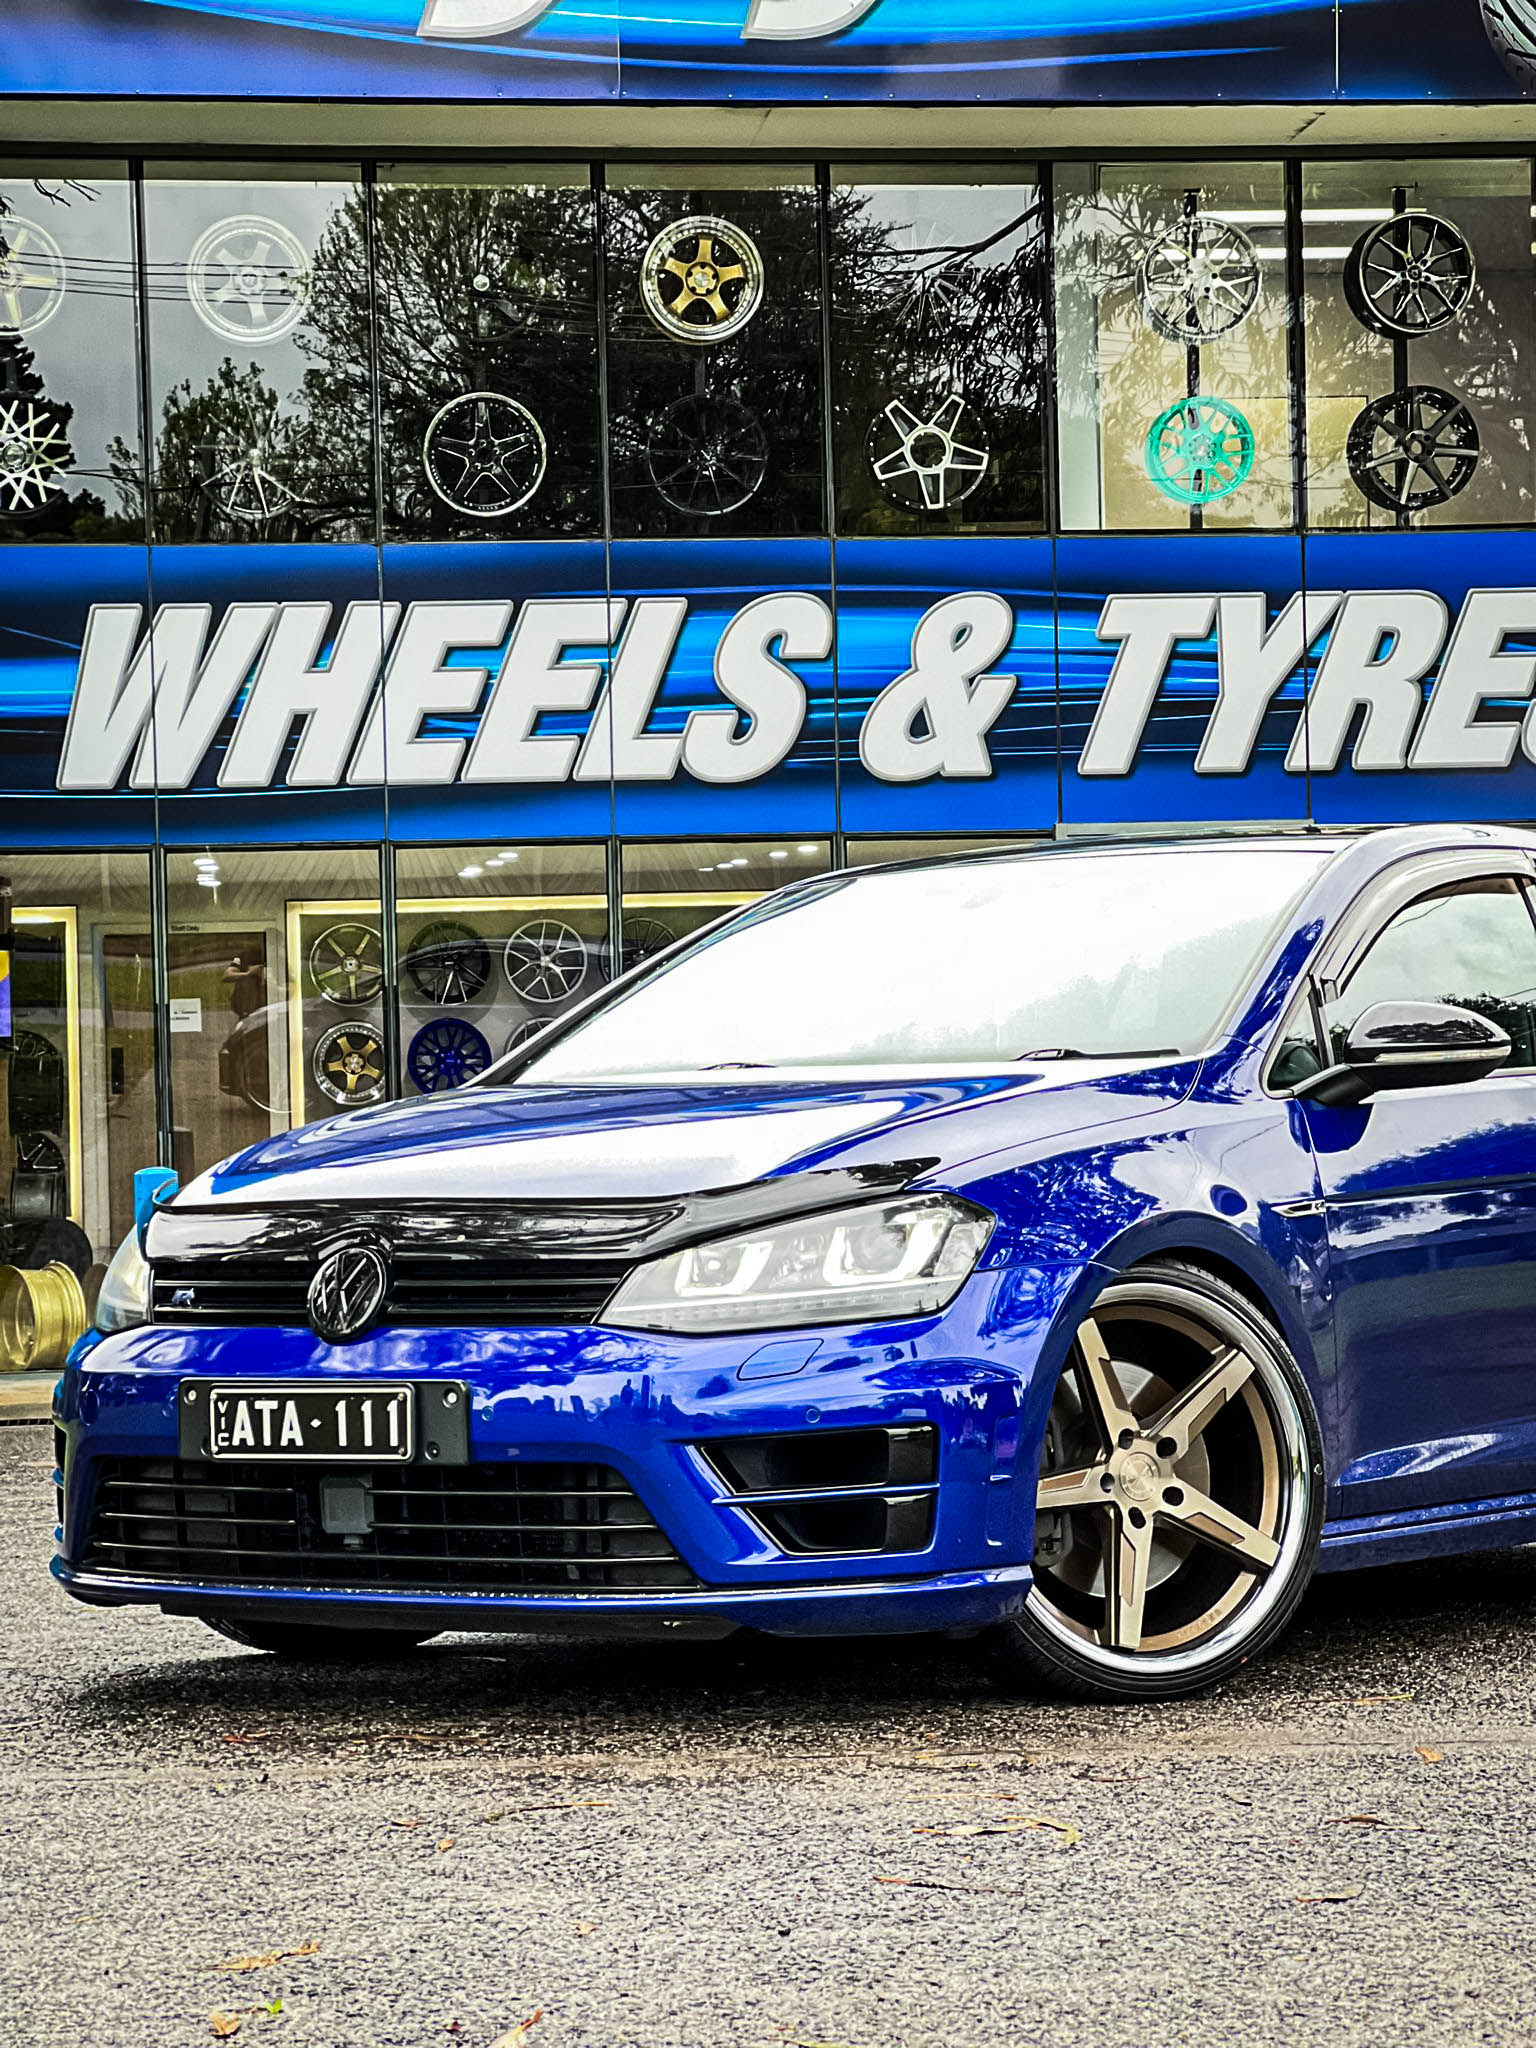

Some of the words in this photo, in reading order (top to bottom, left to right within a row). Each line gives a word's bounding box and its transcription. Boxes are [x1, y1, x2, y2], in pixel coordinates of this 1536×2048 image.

[56, 592, 833, 790] WHEELS
[859, 592, 1016, 781] &
[1077, 588, 1536, 775] TYRE
[217, 1400, 230, 1446] VIC
